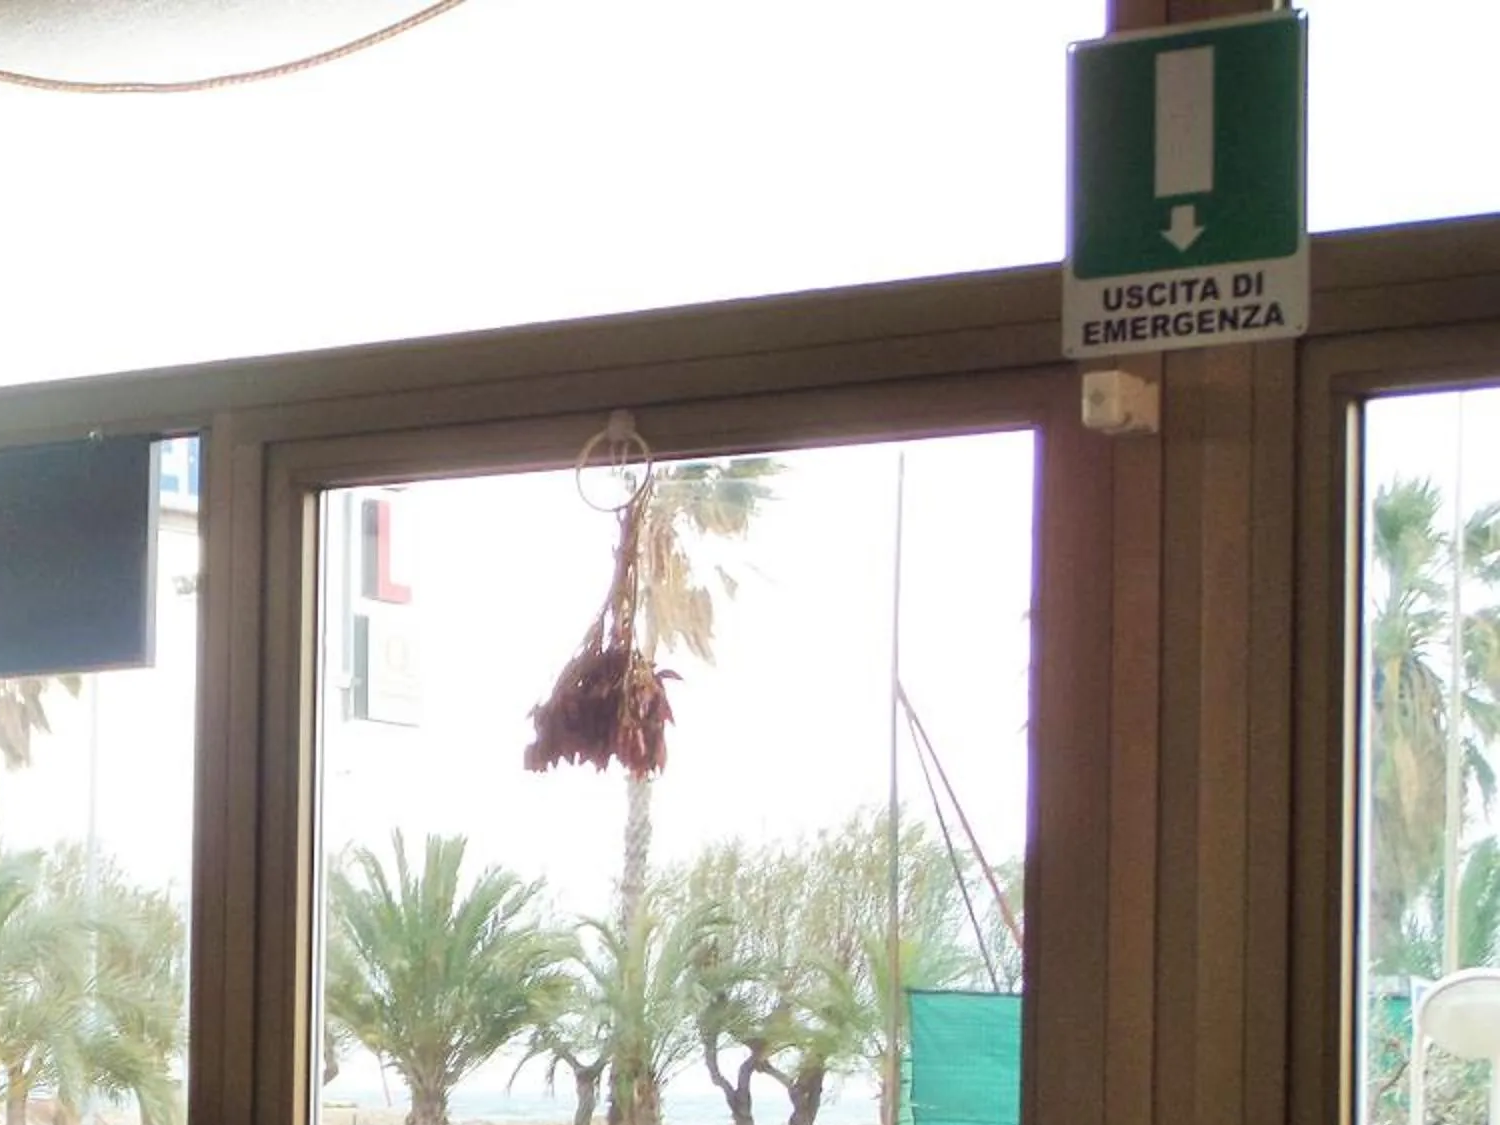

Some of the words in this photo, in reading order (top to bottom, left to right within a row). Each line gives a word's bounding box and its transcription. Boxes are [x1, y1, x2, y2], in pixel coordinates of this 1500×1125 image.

[1102, 275, 1220, 312] USCITA
[1232, 271, 1265, 298] DI
[1082, 302, 1285, 347] EMERGENZA
